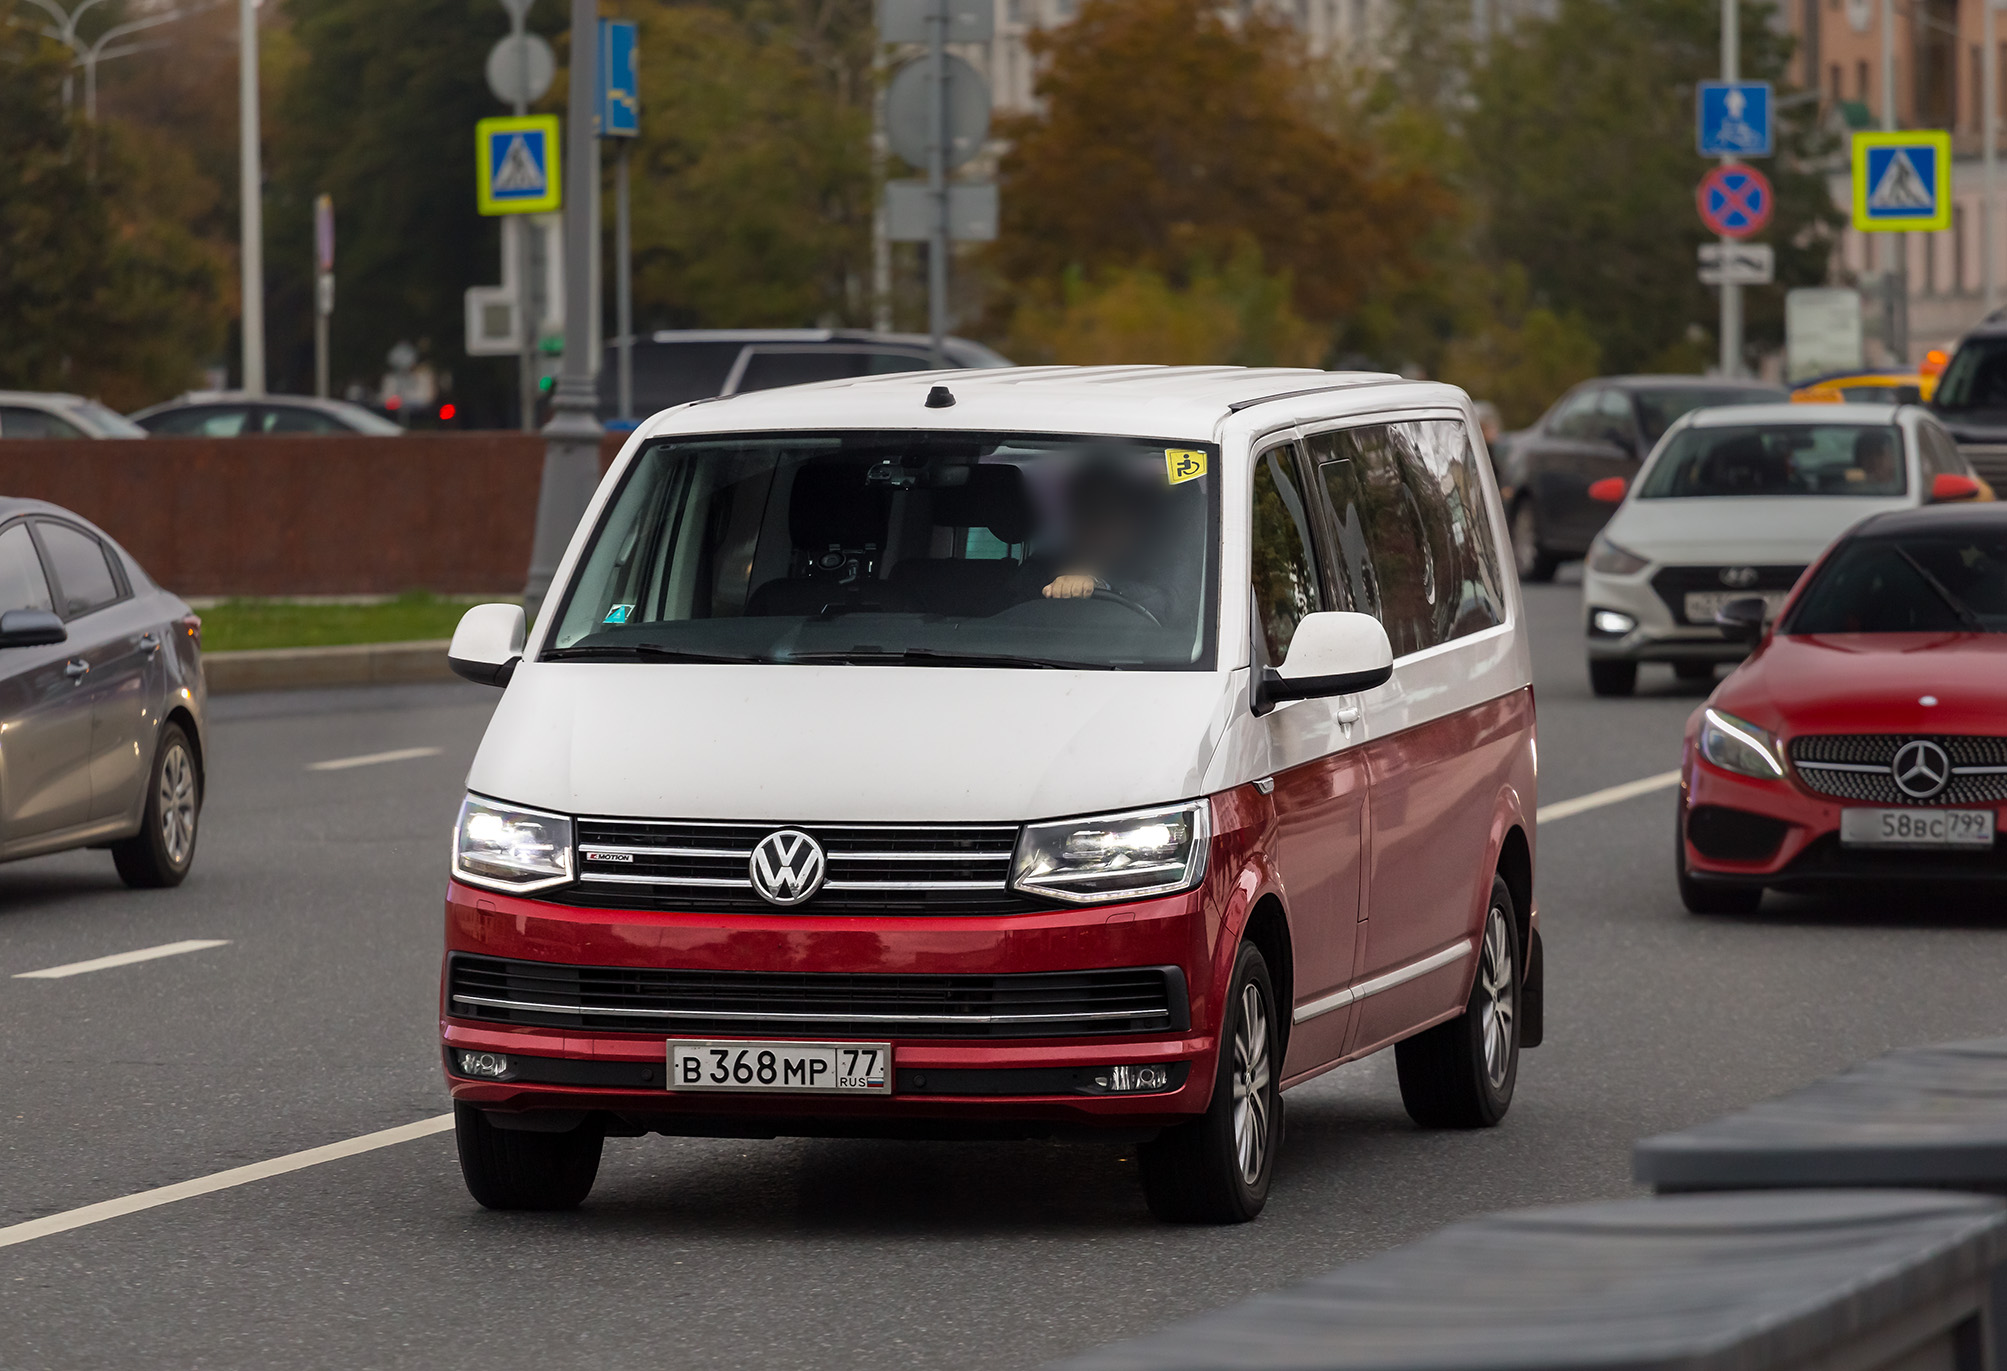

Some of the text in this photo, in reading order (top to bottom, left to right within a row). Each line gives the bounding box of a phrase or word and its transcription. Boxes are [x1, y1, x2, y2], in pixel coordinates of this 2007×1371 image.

[1949, 813, 1986, 832] 799
[843, 1049, 878, 1077] 77
[839, 1077, 866, 1088] RUS
